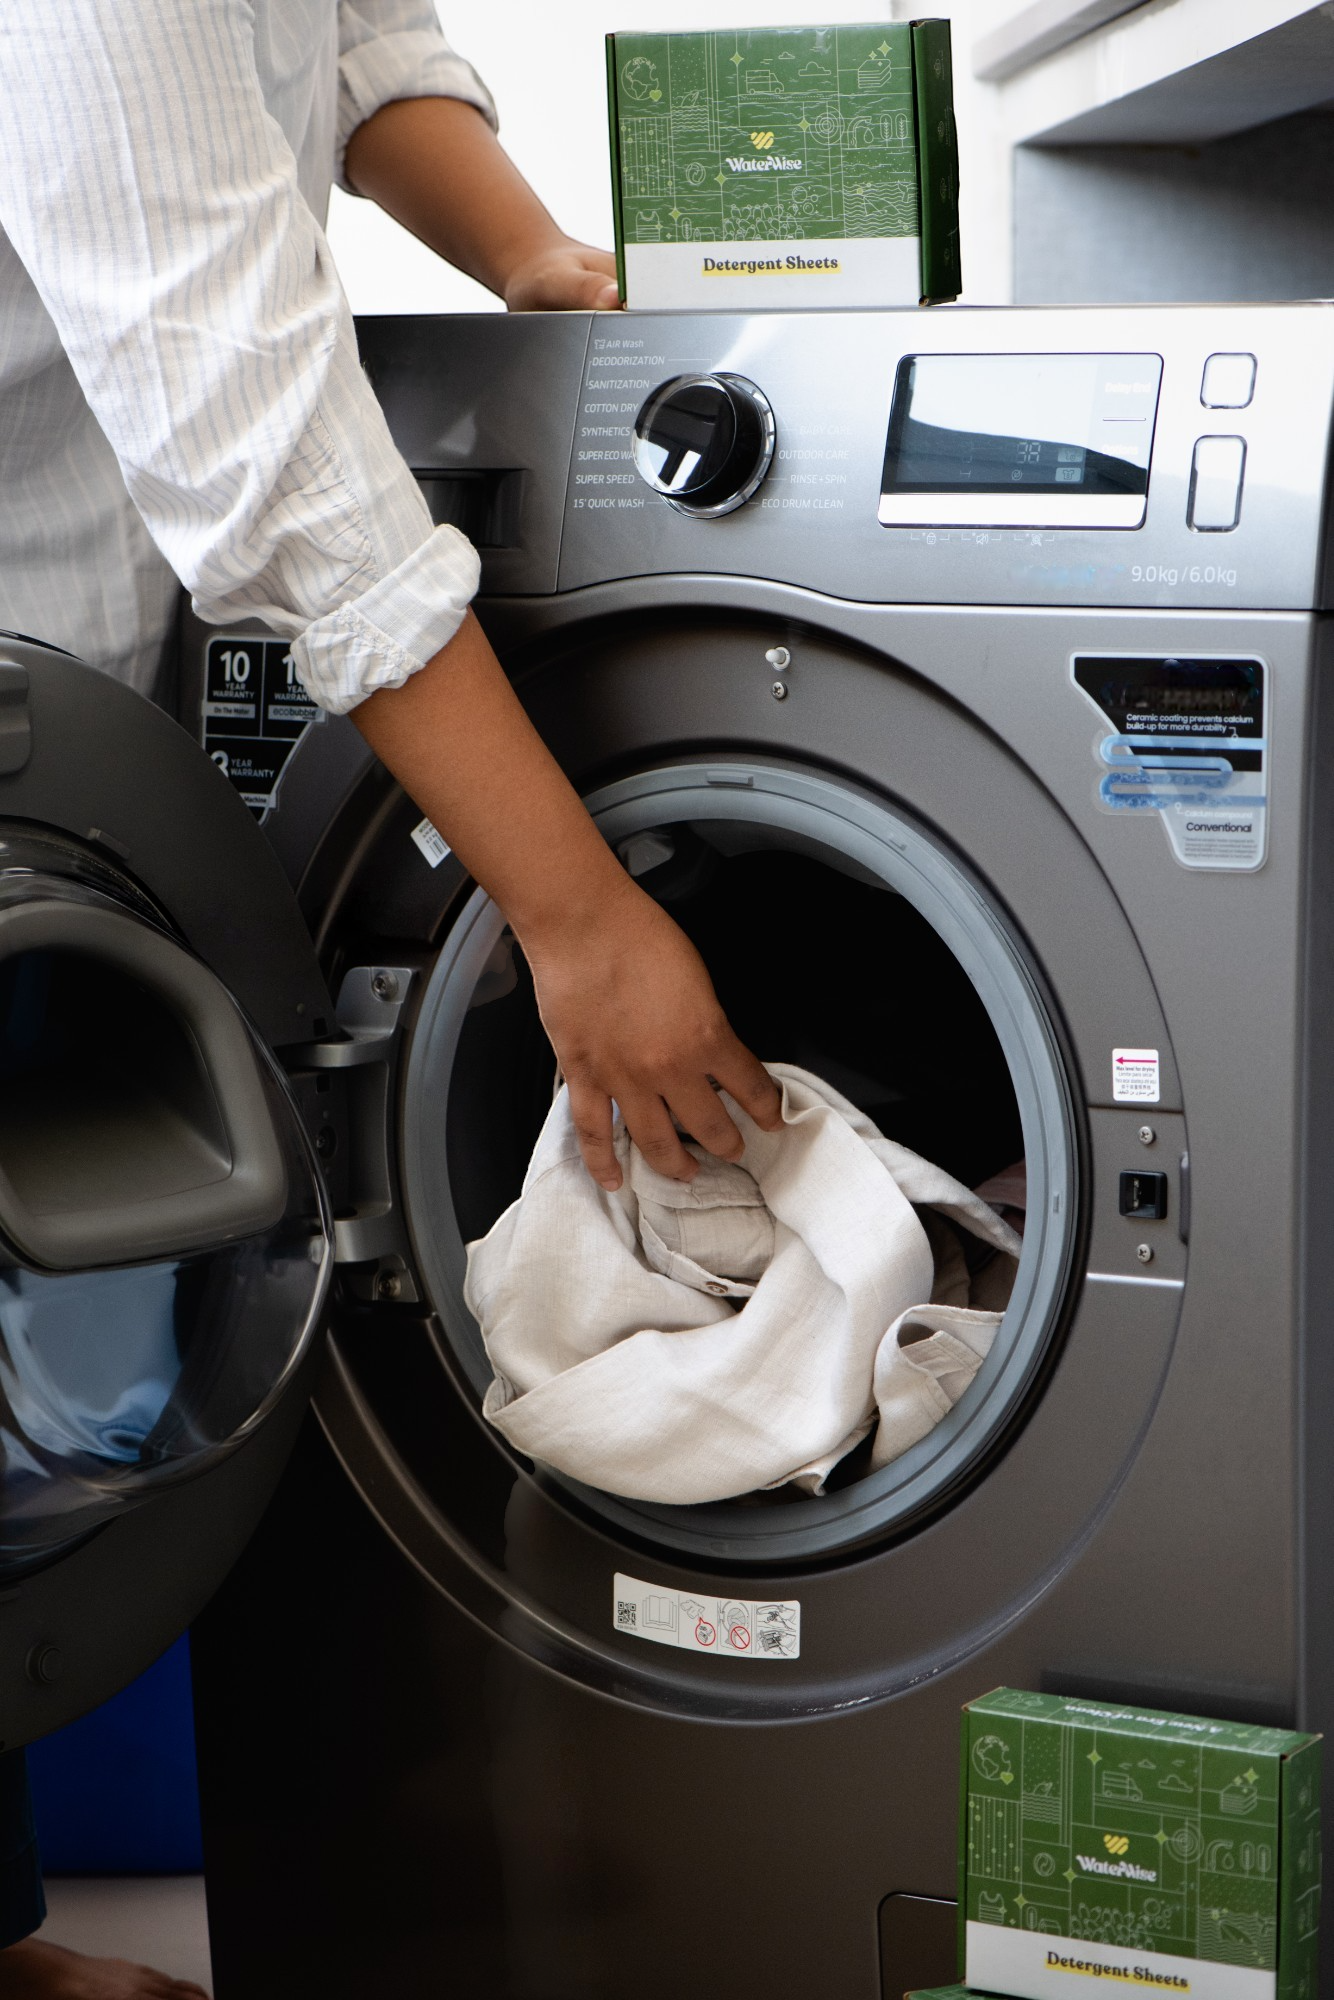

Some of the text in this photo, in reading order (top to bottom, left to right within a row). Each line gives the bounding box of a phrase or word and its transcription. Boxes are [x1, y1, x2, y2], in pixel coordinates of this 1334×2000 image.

[725, 155, 803, 172] WaterWise
[703, 255, 838, 274] Detergent Sheets
[606, 339, 644, 349] AIR Wash
[592, 356, 665, 366] DEODORIZATION
[588, 379, 650, 390] SANITIZATION
[585, 403, 639, 413] COTTON DRY
[581, 426, 631, 437] SYNTHETICS
[578, 451, 604, 460] SUPER
[604, 450, 620, 460] ECO
[778, 450, 850, 460] OUTDOOR CARE
[575, 475, 635, 484] SUPER SPEED
[587, 499, 616, 509] QUICK
[617, 499, 645, 508] WASH
[761, 499, 844, 509] ECO DRUM CLEAN
[220, 650, 250, 682] 10
[212, 690, 255, 699] WARRANTY
[273, 708, 316, 717] ecobubble
[1126, 713, 1254, 725] Ceramic coating prevents calcium
[1126, 722, 1157, 732] build-up
[1157, 722, 1168, 730] for
[1191, 723, 1227, 733] durability
[231, 758, 253, 767] YEAR
[230, 768, 275, 778] WARRANTY
[1186, 822, 1252, 833] Conventional
[1075, 1854, 1157, 1882] WaterWise
[1047, 1951, 1189, 1988] Detergent Sheets
